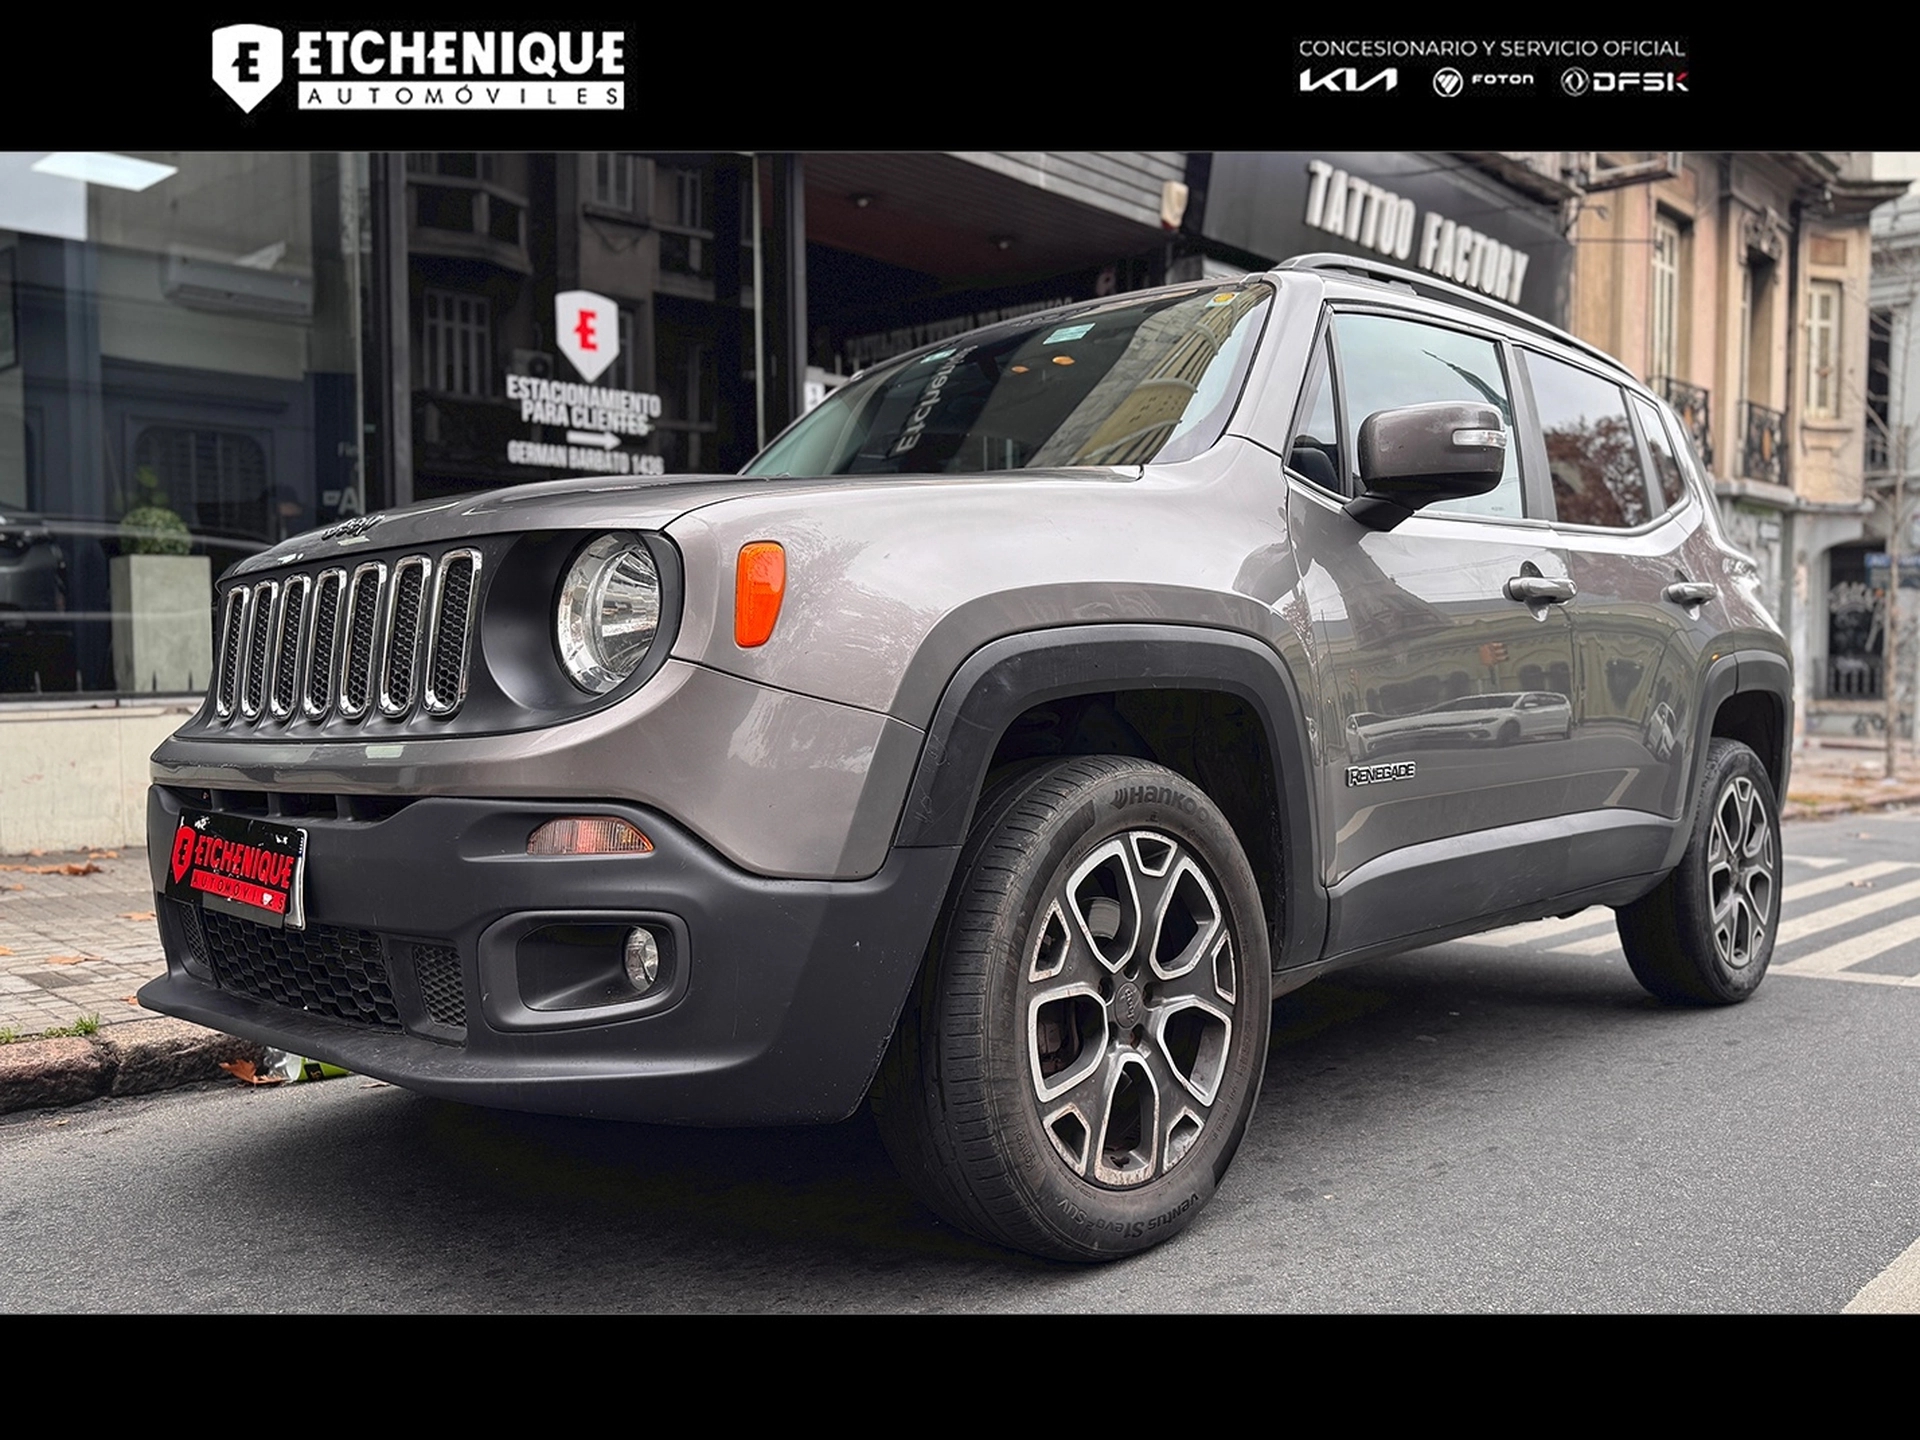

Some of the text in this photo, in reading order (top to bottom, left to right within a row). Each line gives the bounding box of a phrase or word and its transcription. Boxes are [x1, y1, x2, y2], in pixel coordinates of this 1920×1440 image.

[1305, 159, 1530, 305] TATTOO FACTORY
[506, 374, 662, 418] ESTACIONAMIENTO
[521, 399, 649, 436] PARA CLIENTES
[1345, 761, 1416, 787] RENEGADE
[1130, 785, 1224, 838] Hankoo
[195, 835, 296, 889] ETCHENIQUE
[192, 874, 285, 910] AUTOMÓVIS
